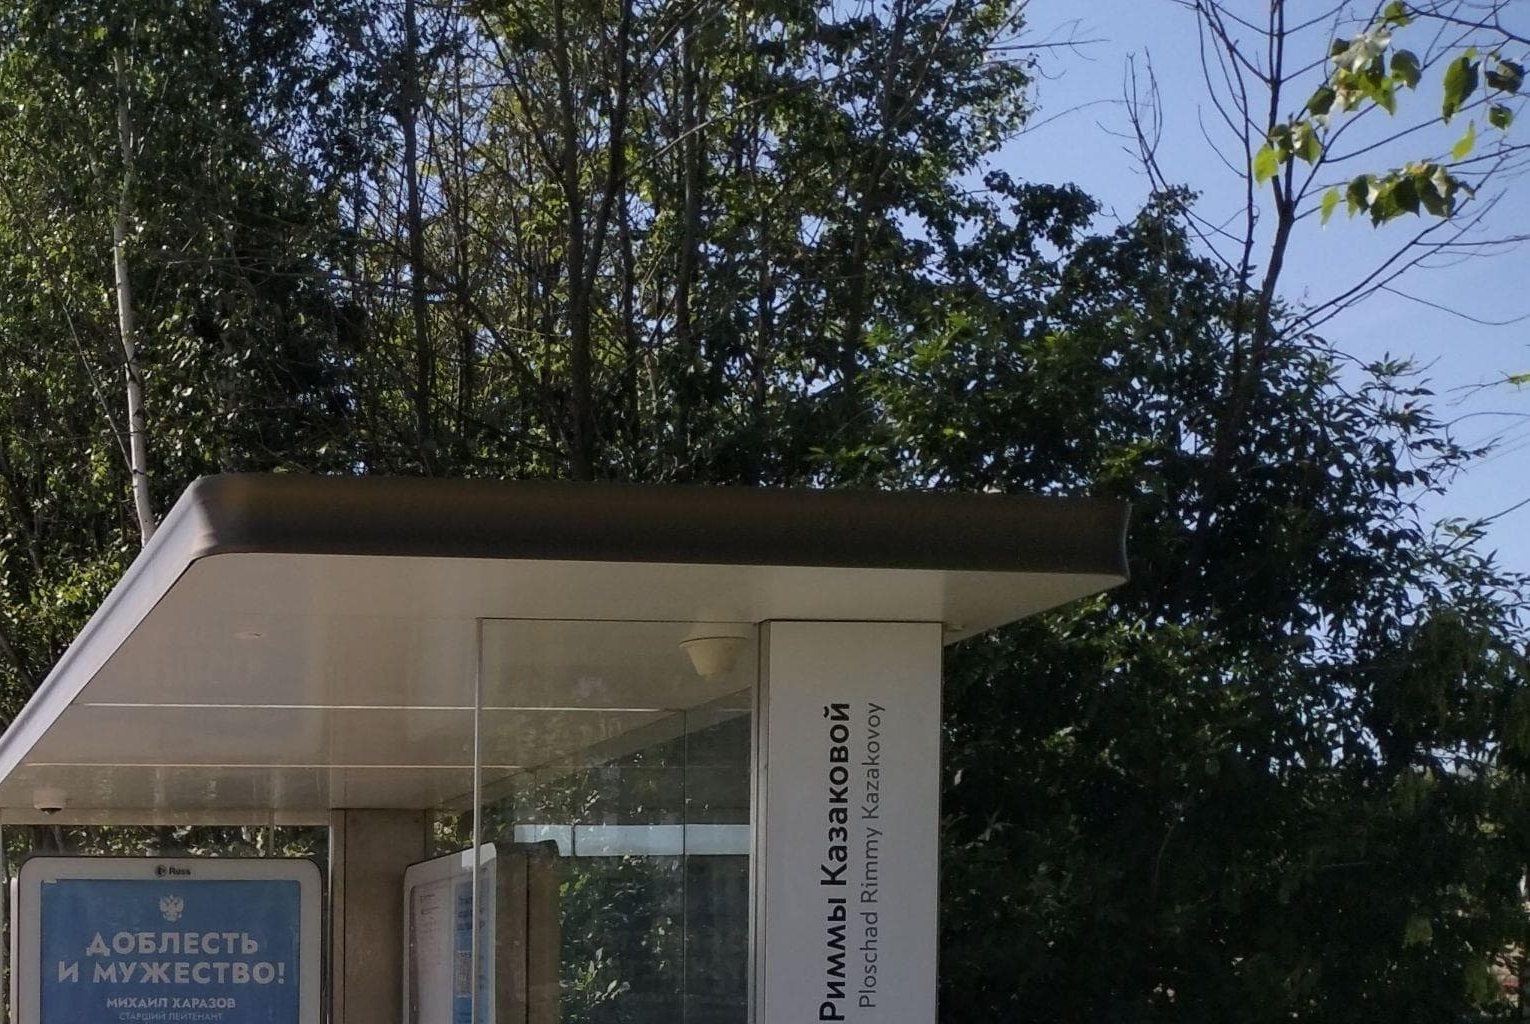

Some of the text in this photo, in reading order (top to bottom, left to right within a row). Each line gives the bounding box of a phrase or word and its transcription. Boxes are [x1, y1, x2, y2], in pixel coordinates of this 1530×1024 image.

[820, 702, 851, 886] Казаковой
[858, 702, 886, 1008] Ploschad Rimmy Kazakovoy
[86, 931, 259, 957] ДОБЛЕСТЬ
[819, 897, 847, 1021] Риммы
[58, 960, 286, 985] И МУЖЕСТВО!
[106, 997, 236, 1009] МИХАИЛ ХАРАЗОВ
[119, 1011, 166, 1021] СТАРШИЙ
